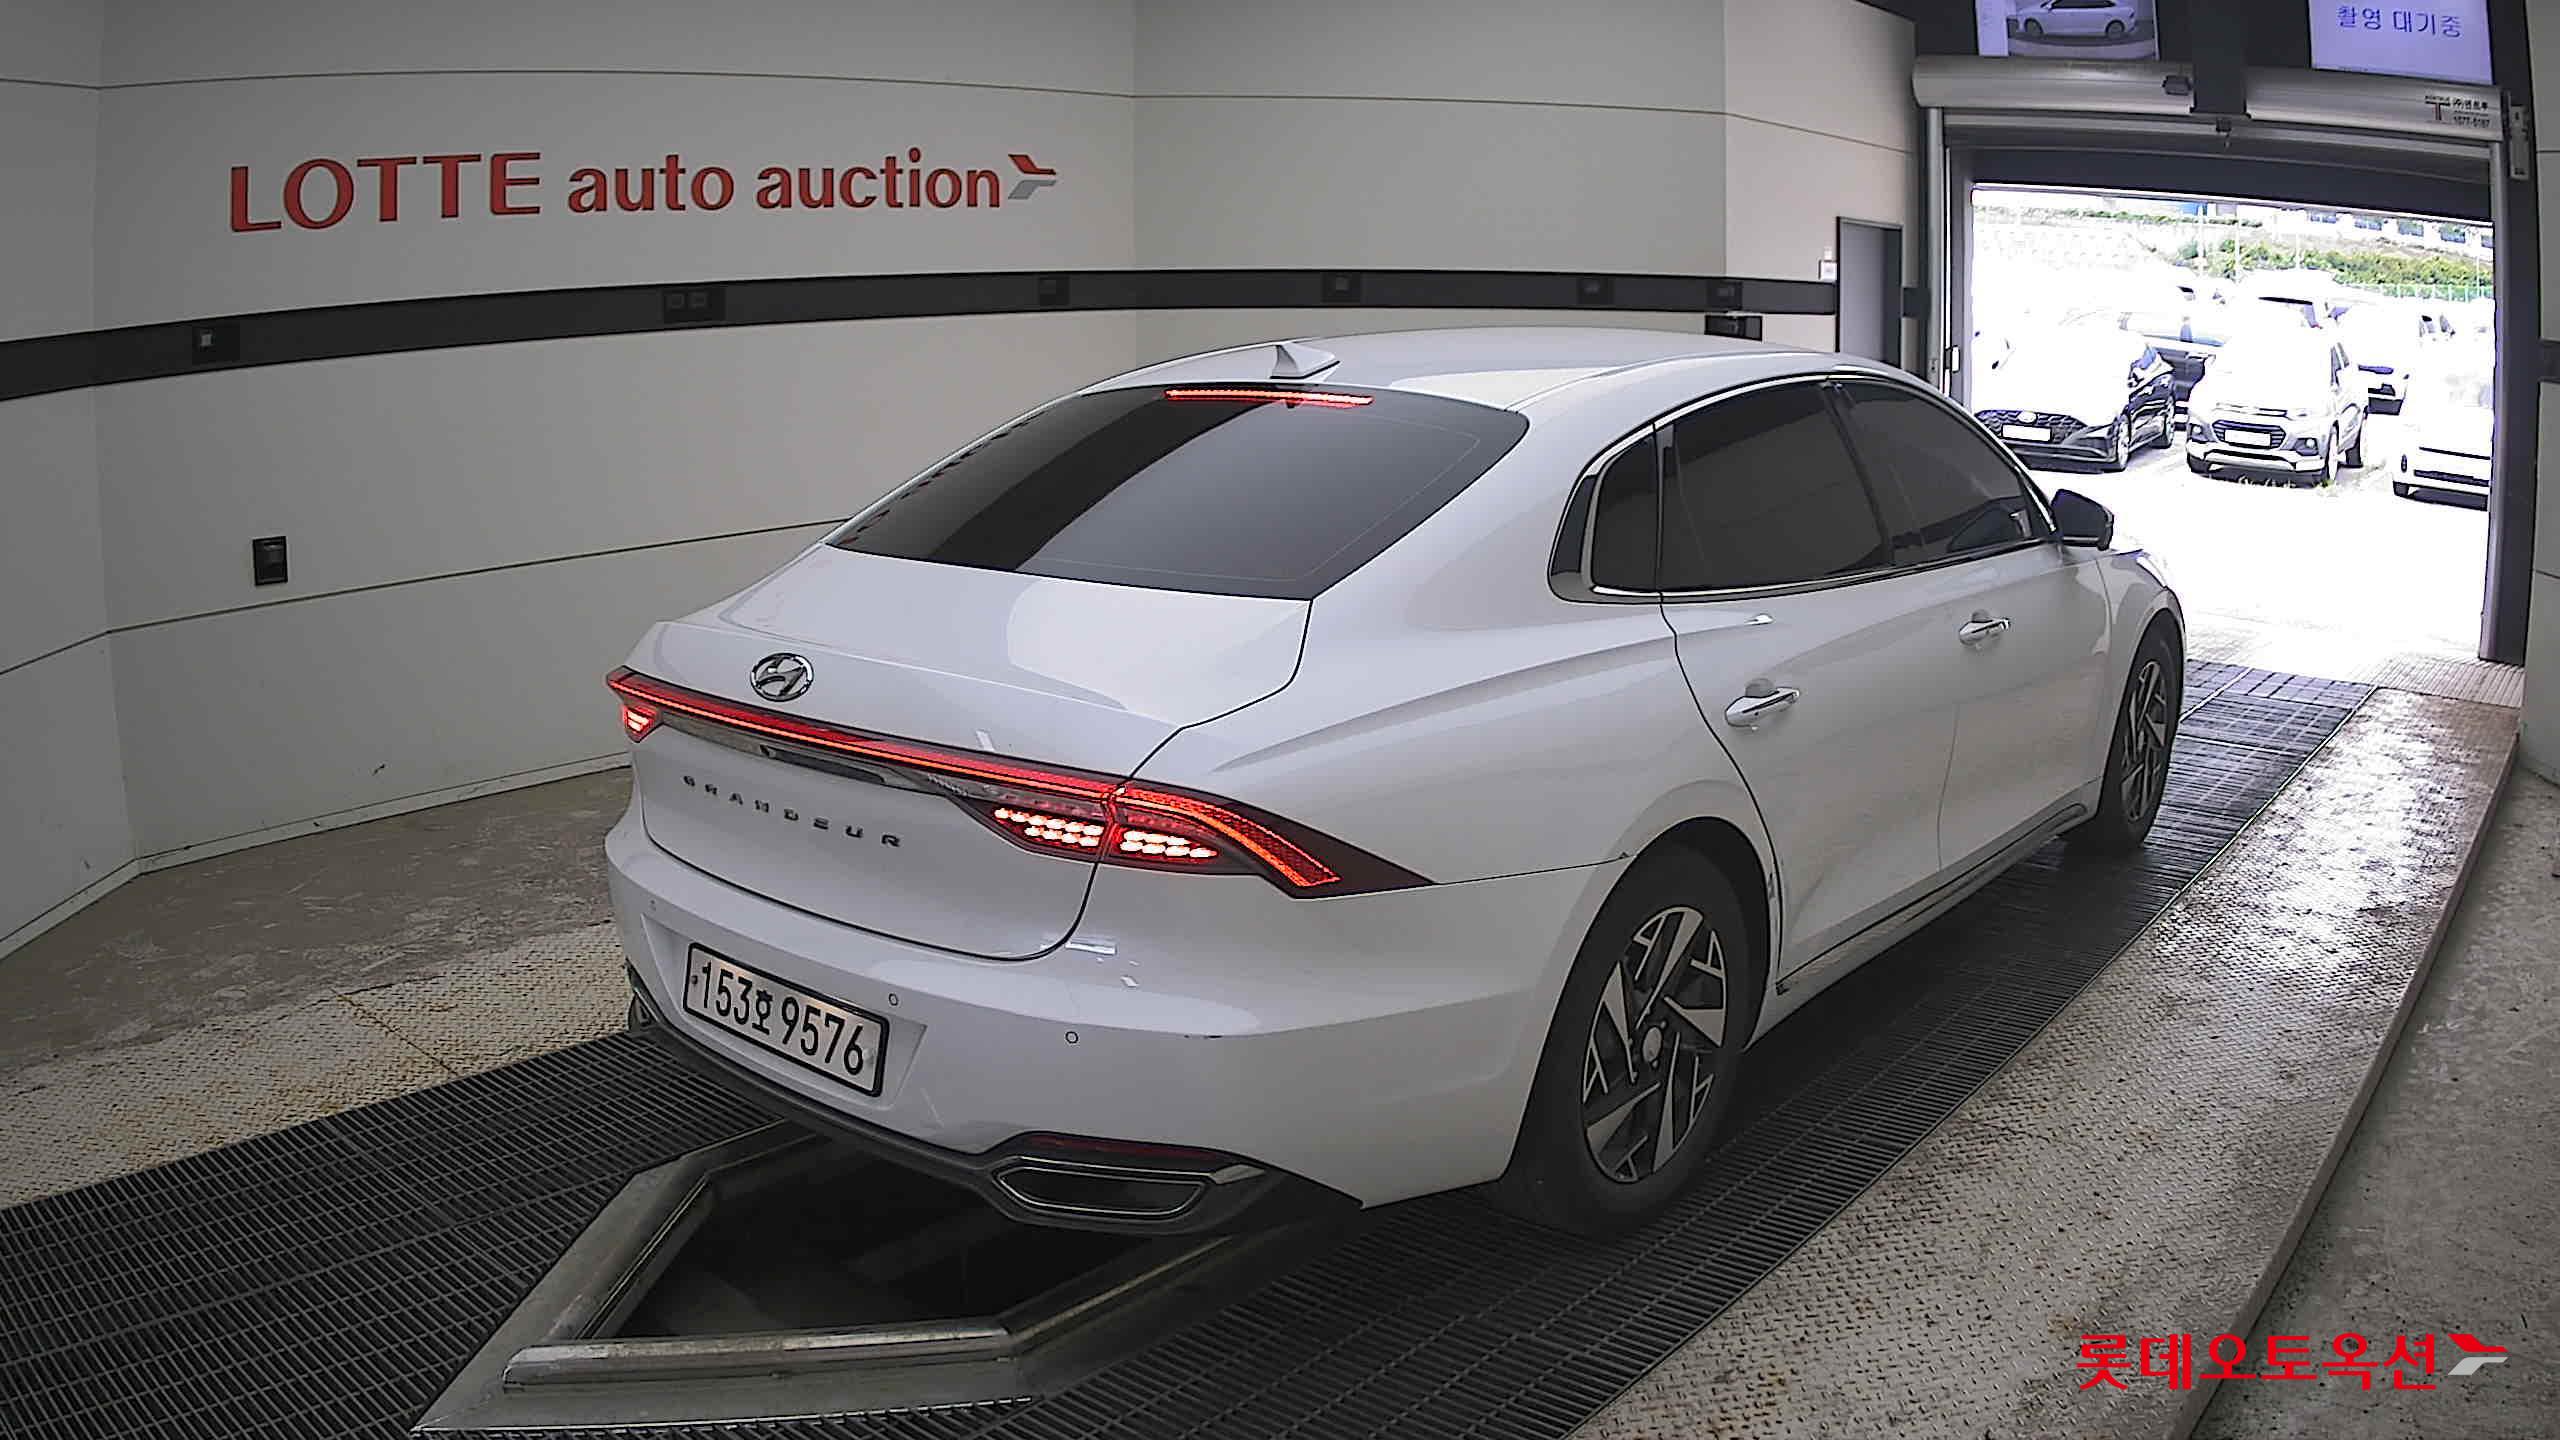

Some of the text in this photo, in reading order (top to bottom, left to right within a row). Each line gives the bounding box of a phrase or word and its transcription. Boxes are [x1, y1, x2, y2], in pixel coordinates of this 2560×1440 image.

[2338, 5, 2462, 39] 촬영 대기중
[230, 148, 1004, 233] LOTTE auto auction
[682, 774, 901, 849] GRANDEUR
